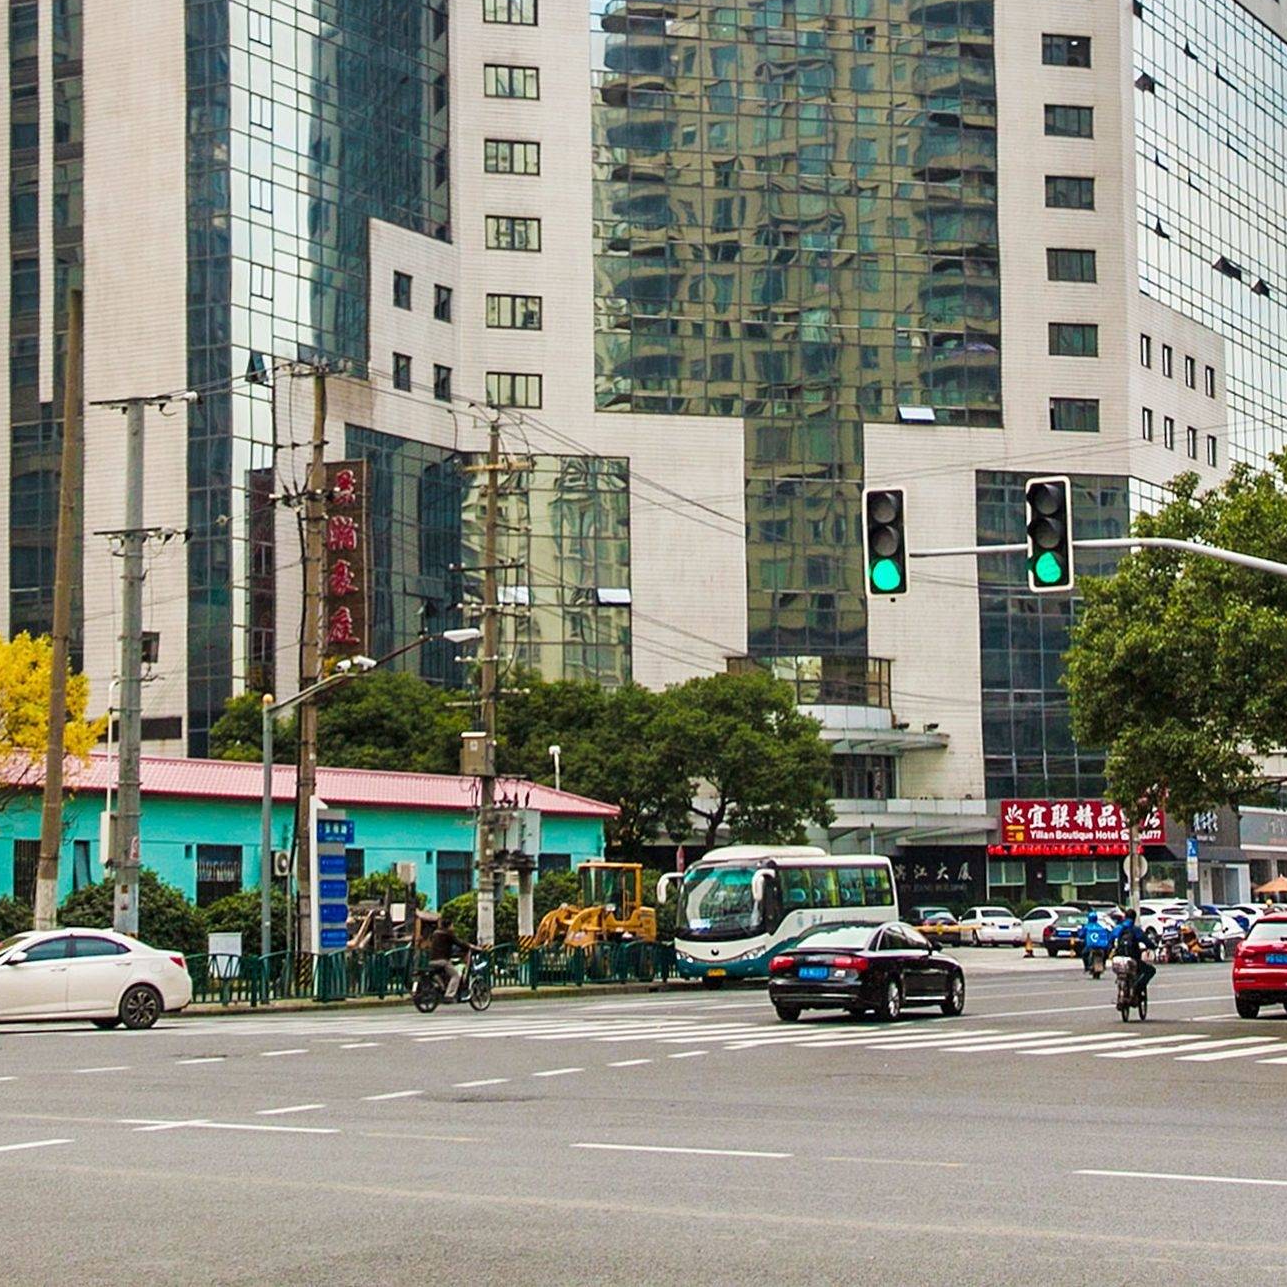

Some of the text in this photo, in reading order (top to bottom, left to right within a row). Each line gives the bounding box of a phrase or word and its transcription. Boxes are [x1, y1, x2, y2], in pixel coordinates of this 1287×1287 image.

[1027, 803, 1161, 829] 宜联精品店
[1056, 830, 1094, 841] Boutique
[1095, 830, 1118, 840] Hotel
